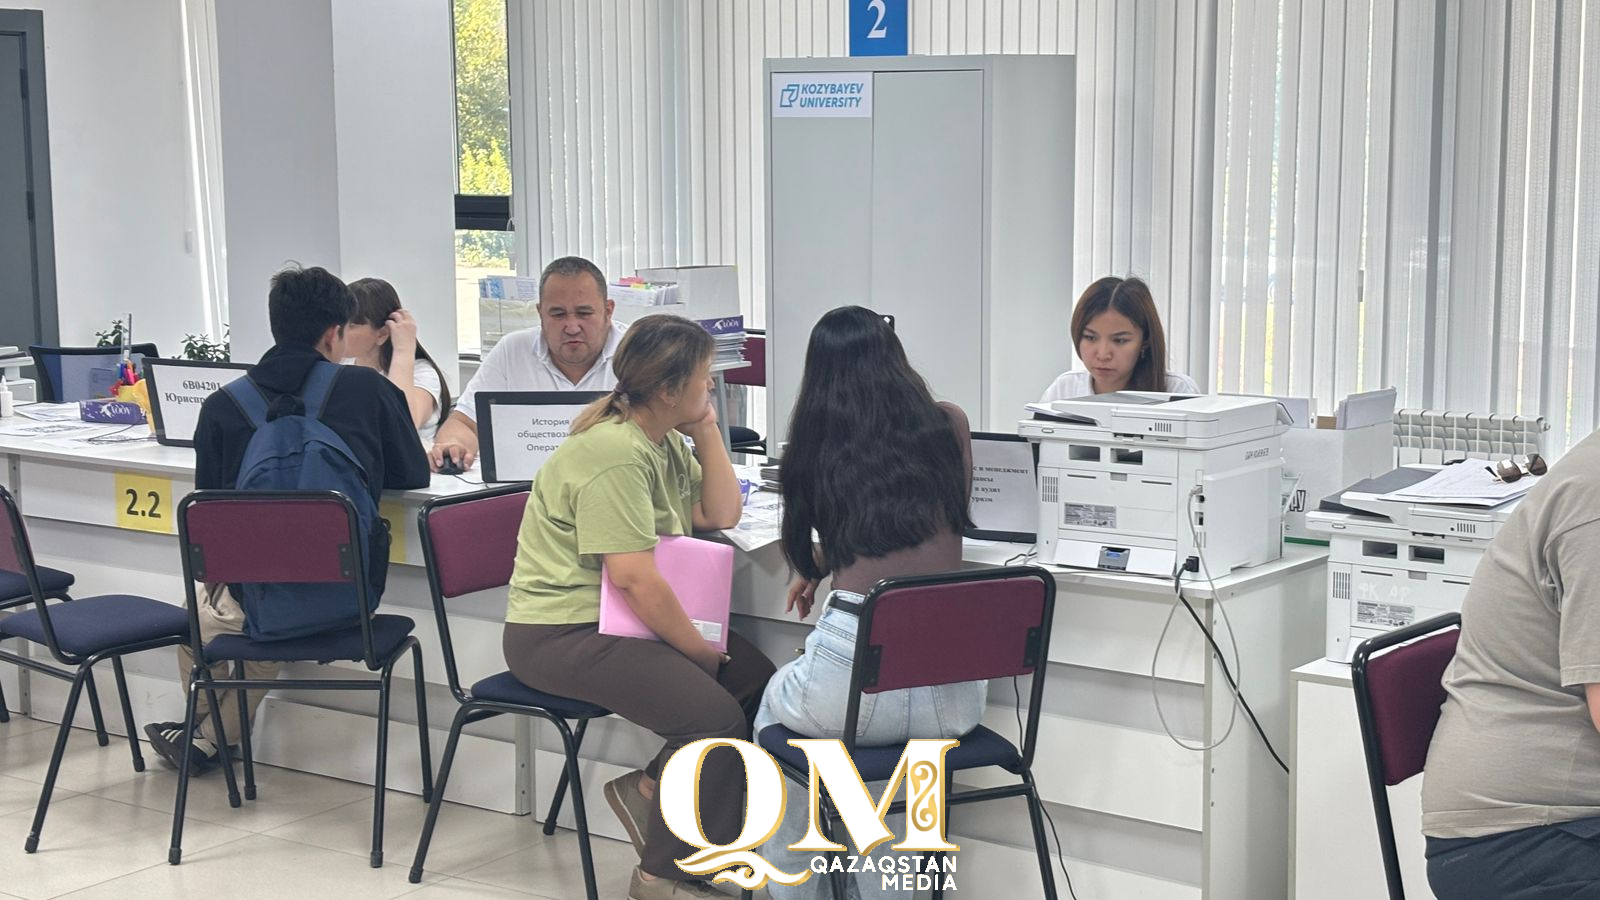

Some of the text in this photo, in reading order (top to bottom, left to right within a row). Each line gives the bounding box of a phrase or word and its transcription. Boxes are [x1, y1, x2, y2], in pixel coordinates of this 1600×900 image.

[867, 0, 887, 39] 2
[801, 83, 864, 95] KOZYBAYEV
[800, 97, 862, 108] UNIVERSITY
[182, 380, 220, 391] 6B04201
[165, 392, 206, 404] Юриспр
[531, 418, 570, 427] История
[517, 431, 569, 439] обществоз
[526, 444, 559, 452] Операт
[126, 488, 162, 518] 2.2
